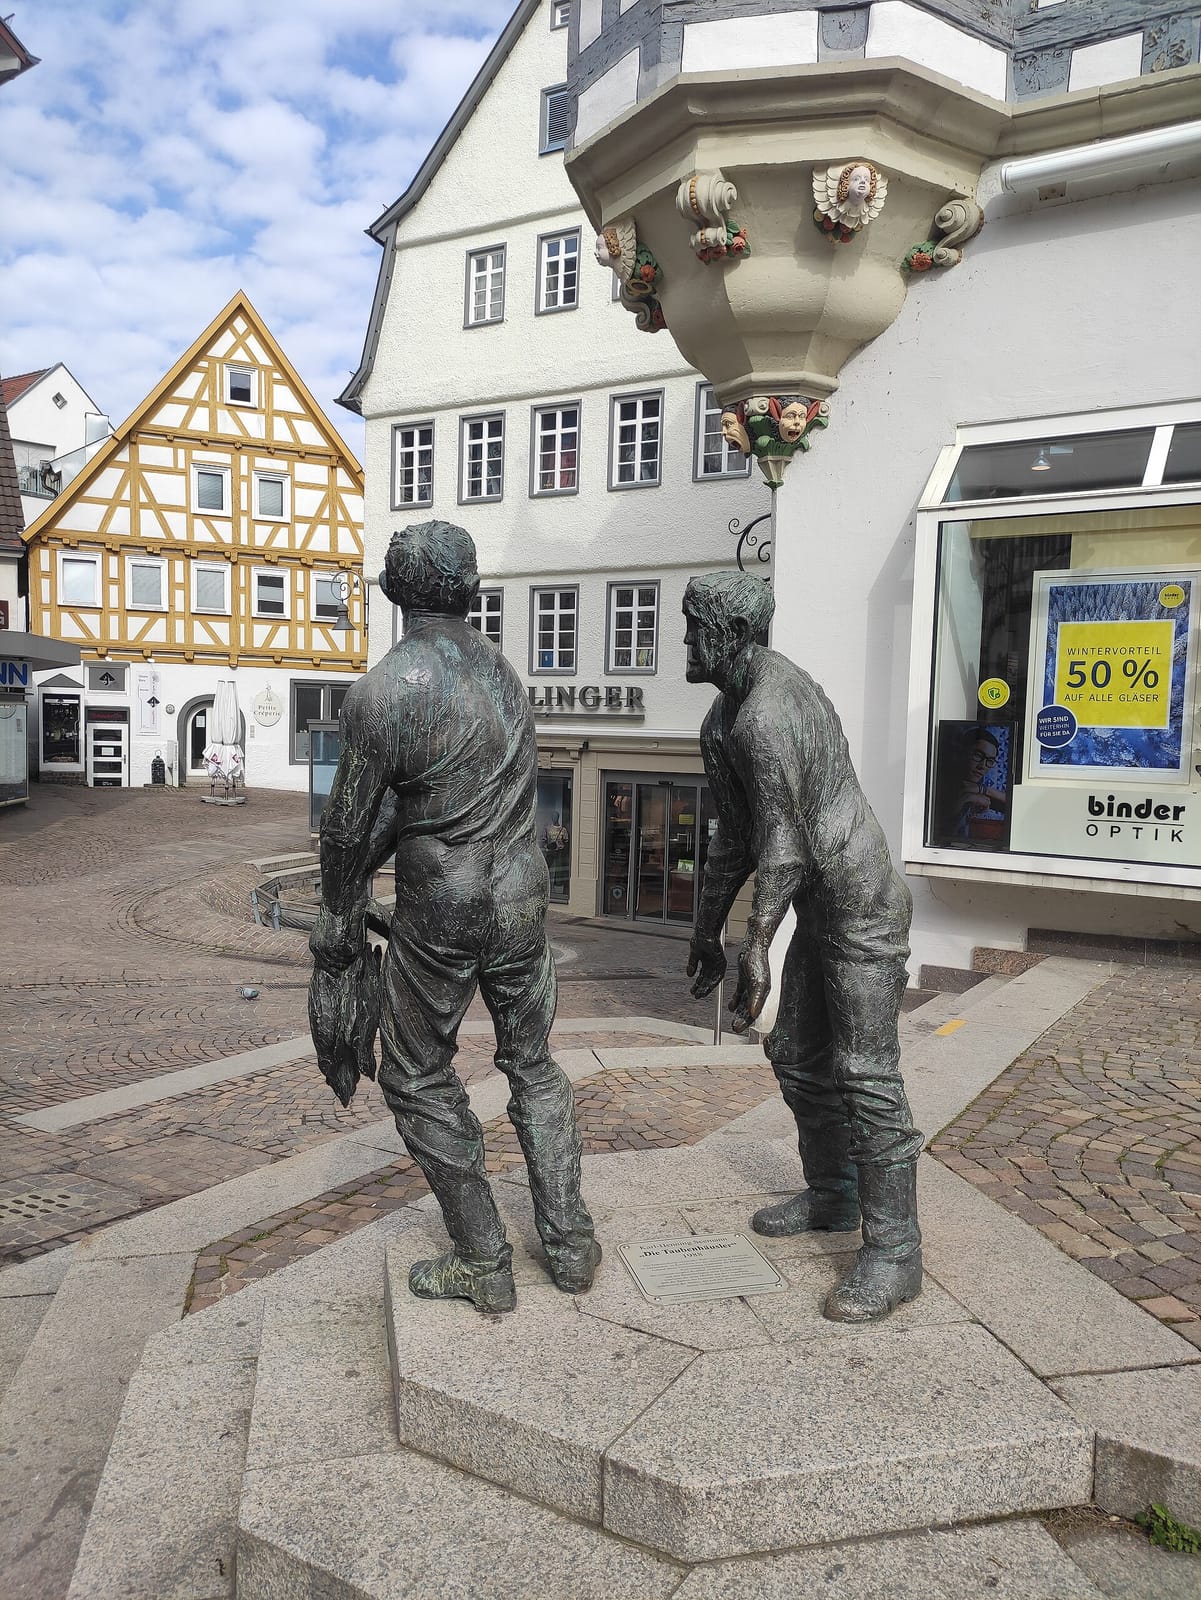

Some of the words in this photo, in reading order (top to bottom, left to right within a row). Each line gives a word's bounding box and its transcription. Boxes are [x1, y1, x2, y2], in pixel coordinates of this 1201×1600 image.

[1067, 646, 1162, 656] WINTERVORTEIL
[1066, 660, 1112, 689] 50
[1122, 659, 1159, 689] %
[1064, 693, 1084, 702] AUF
[1088, 693, 1113, 702] ALLE
[1119, 692, 1159, 702] GLÄSER
[1053, 715, 1069, 723] SIND
[1088, 794, 1186, 821] binder
[1086, 824, 1183, 843] OPTIK
